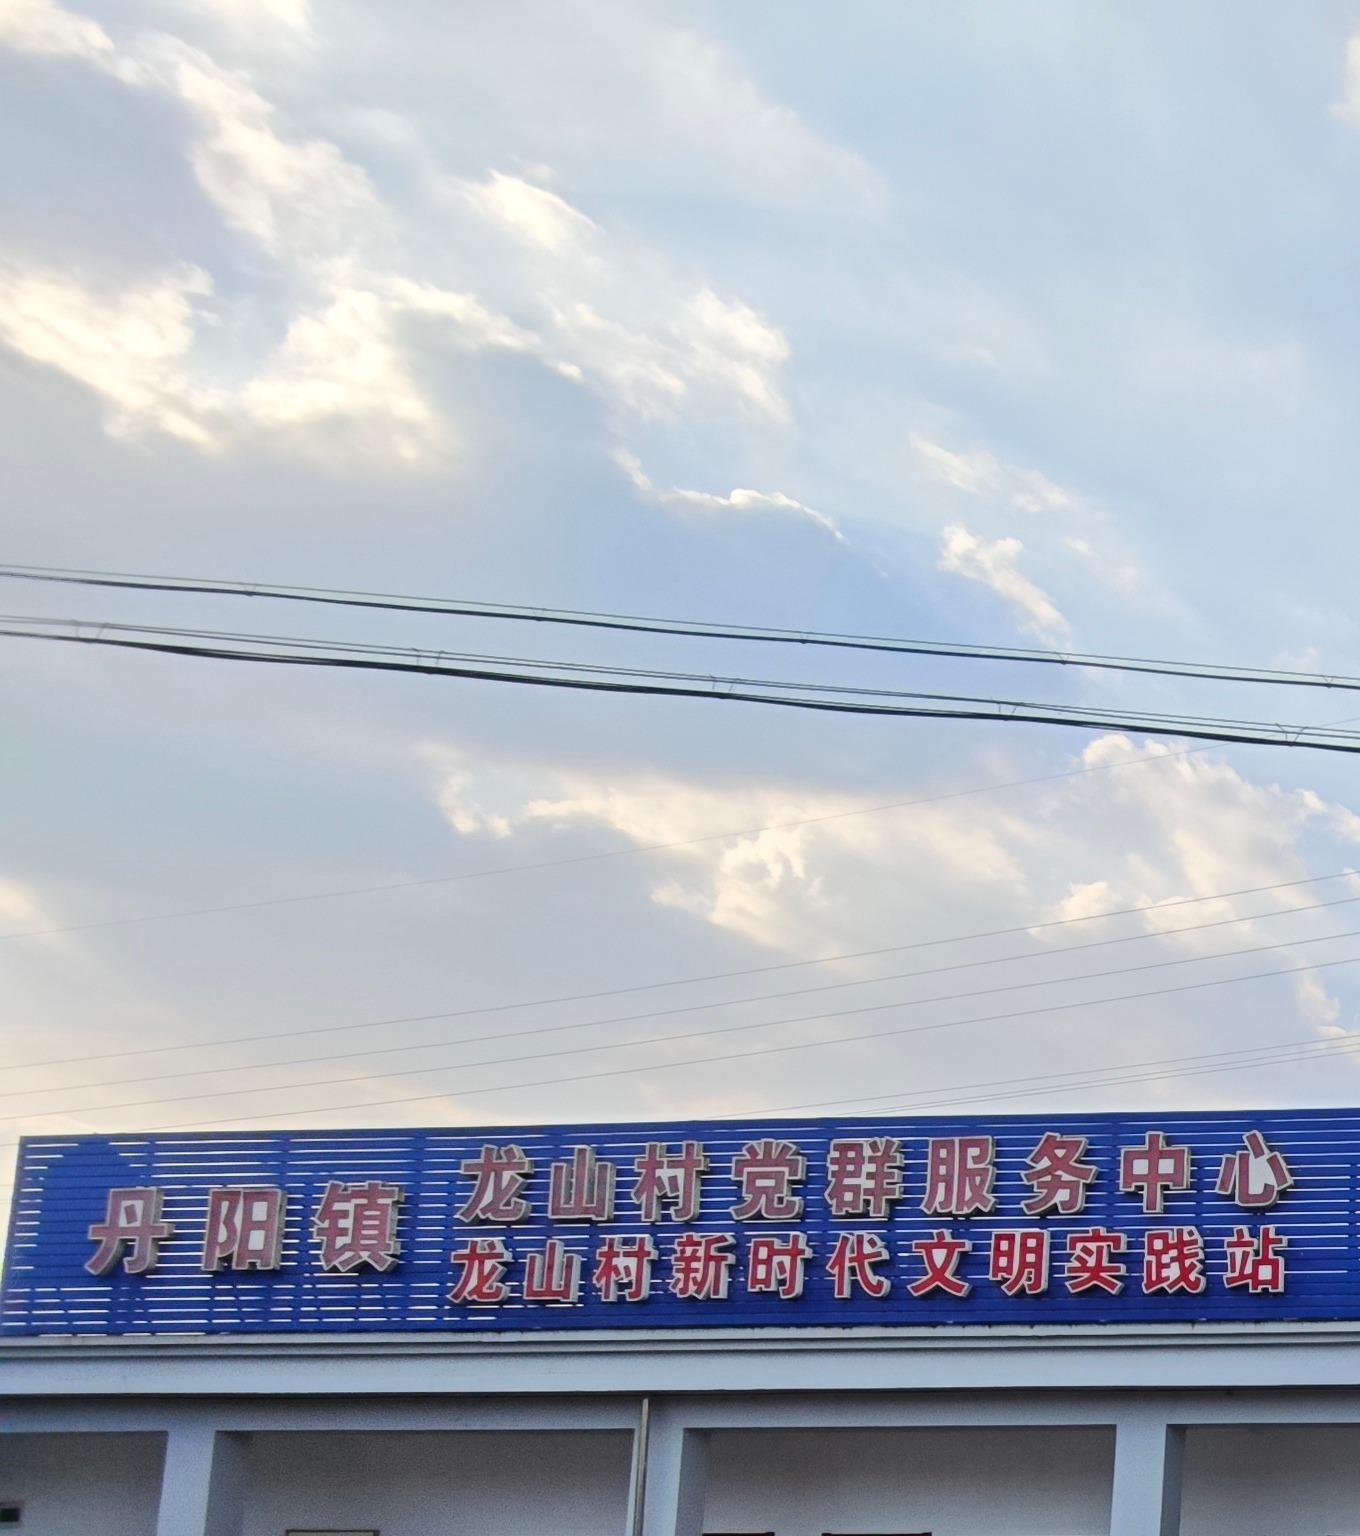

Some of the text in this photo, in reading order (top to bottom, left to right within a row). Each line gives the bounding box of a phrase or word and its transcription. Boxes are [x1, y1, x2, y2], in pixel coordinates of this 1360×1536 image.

[452, 1130, 1294, 1223] 龙山村党群服务中心
[85, 1179, 405, 1276] 丹阳镇
[449, 1225, 1287, 1305] 龙山村新时代文明实践站
